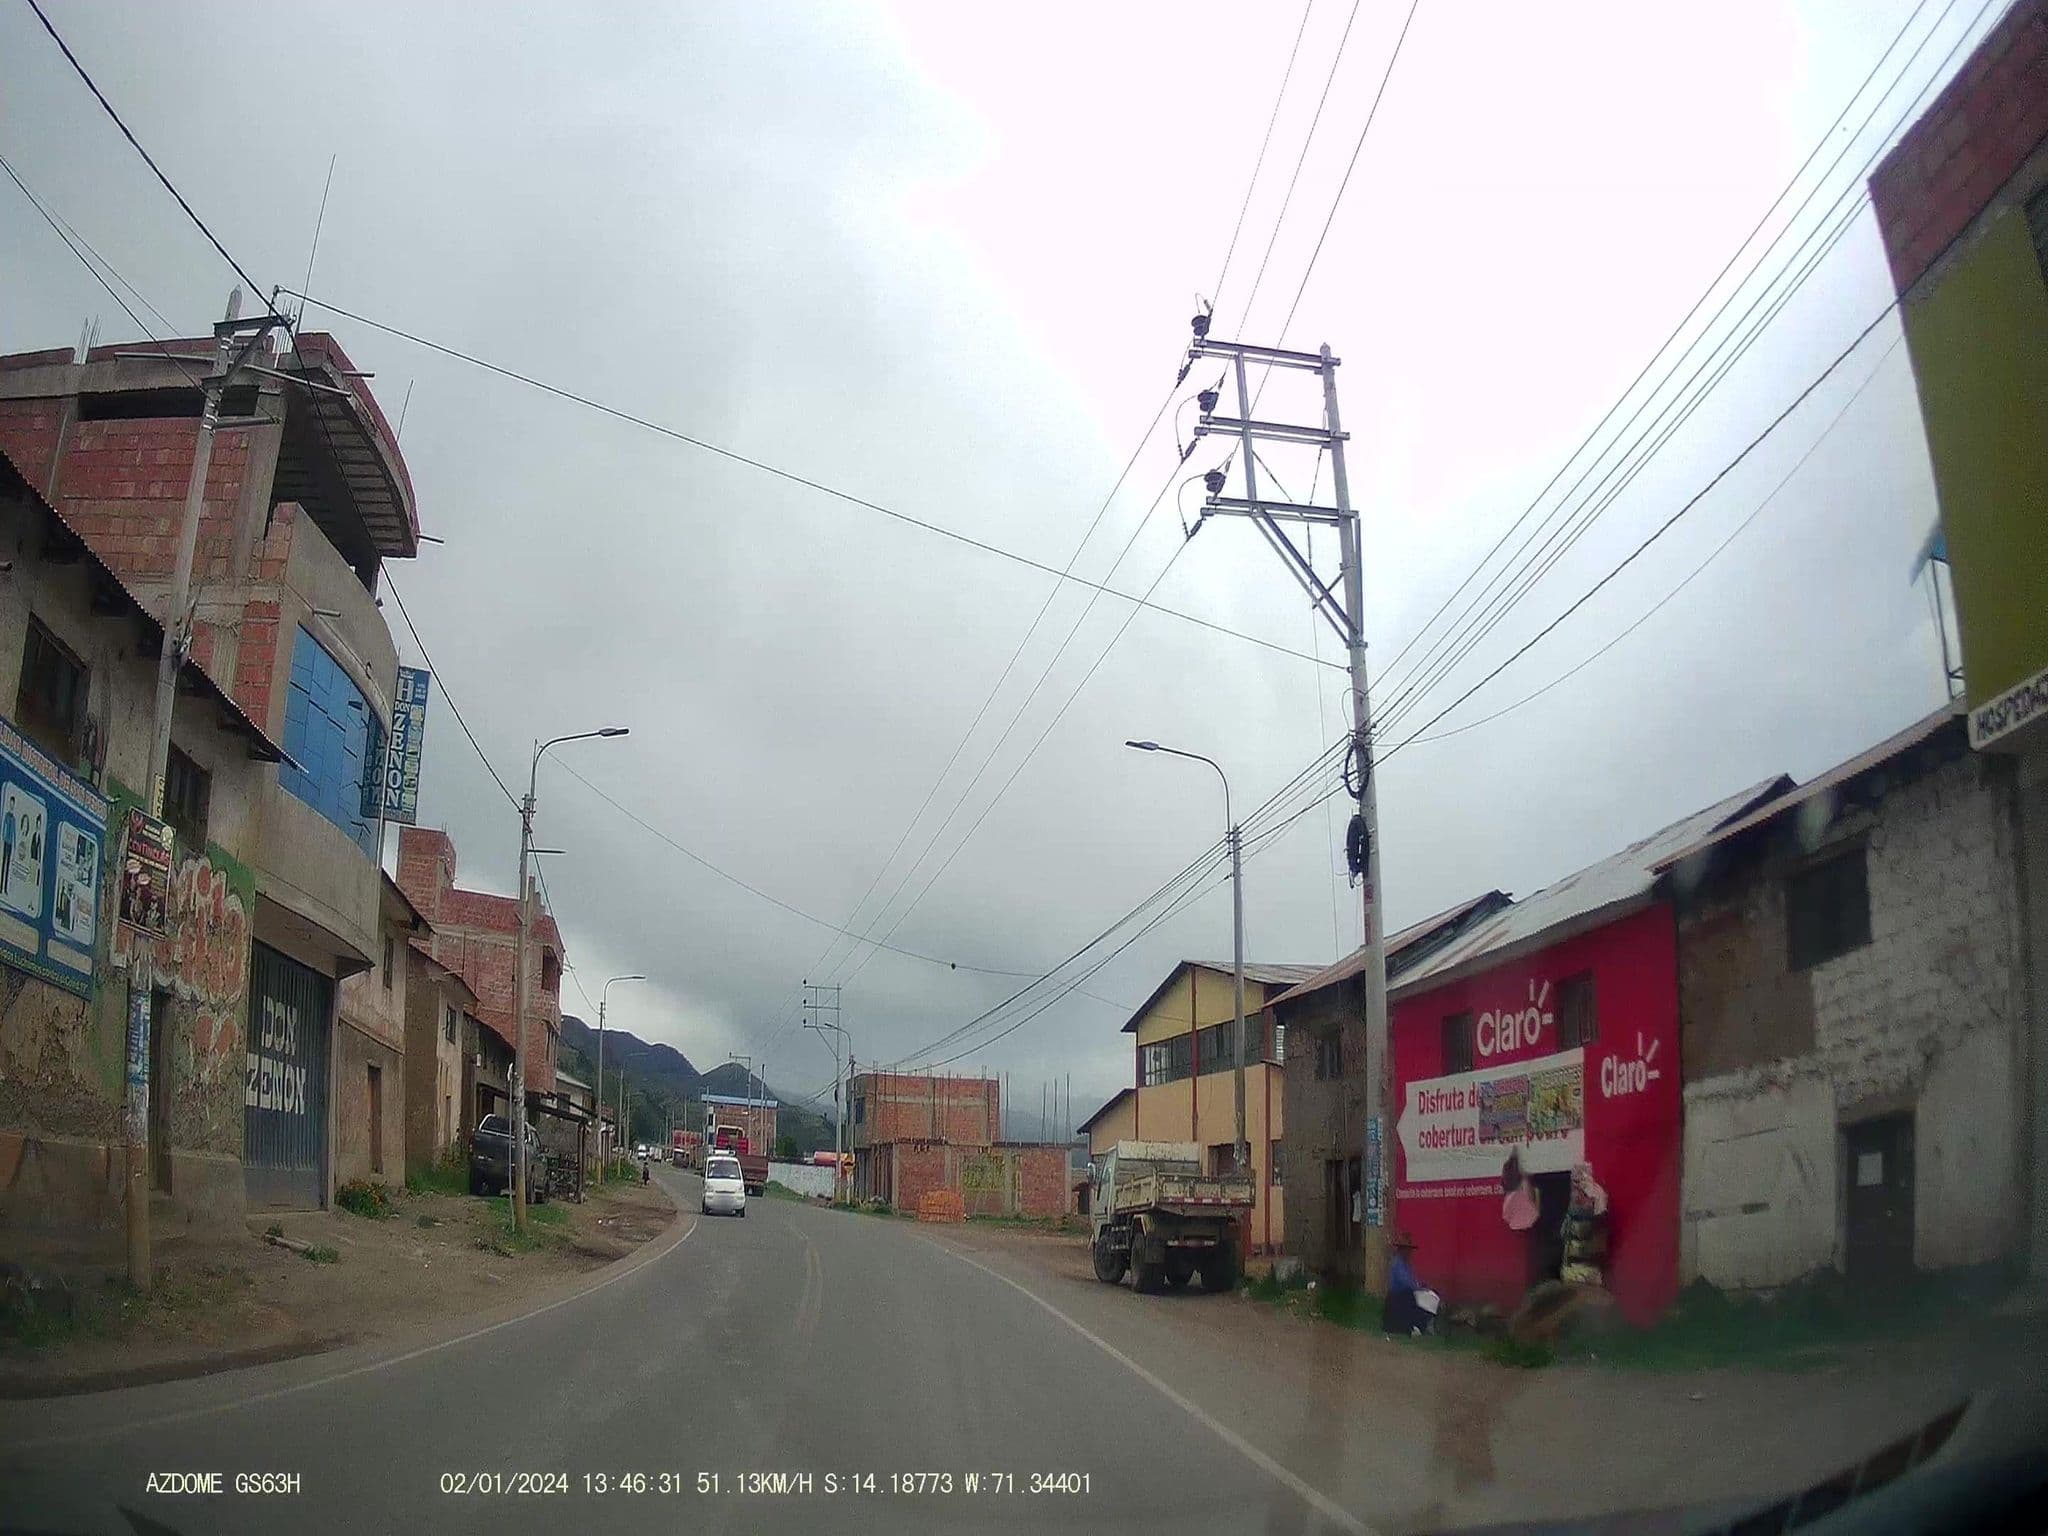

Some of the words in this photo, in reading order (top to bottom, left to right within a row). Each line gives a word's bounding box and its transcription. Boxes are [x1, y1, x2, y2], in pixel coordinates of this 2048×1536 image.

[394, 701, 411, 713] DON
[386, 712, 406, 808] ZENON
[261, 995, 298, 1056] DON
[1476, 1005, 1542, 1058] Claro
[246, 1052, 306, 1115] ZENON
[1418, 1086, 1465, 1115] Disfruta
[1600, 1053, 1648, 1099] Claro
[1418, 1124, 1476, 1149] cobertura
